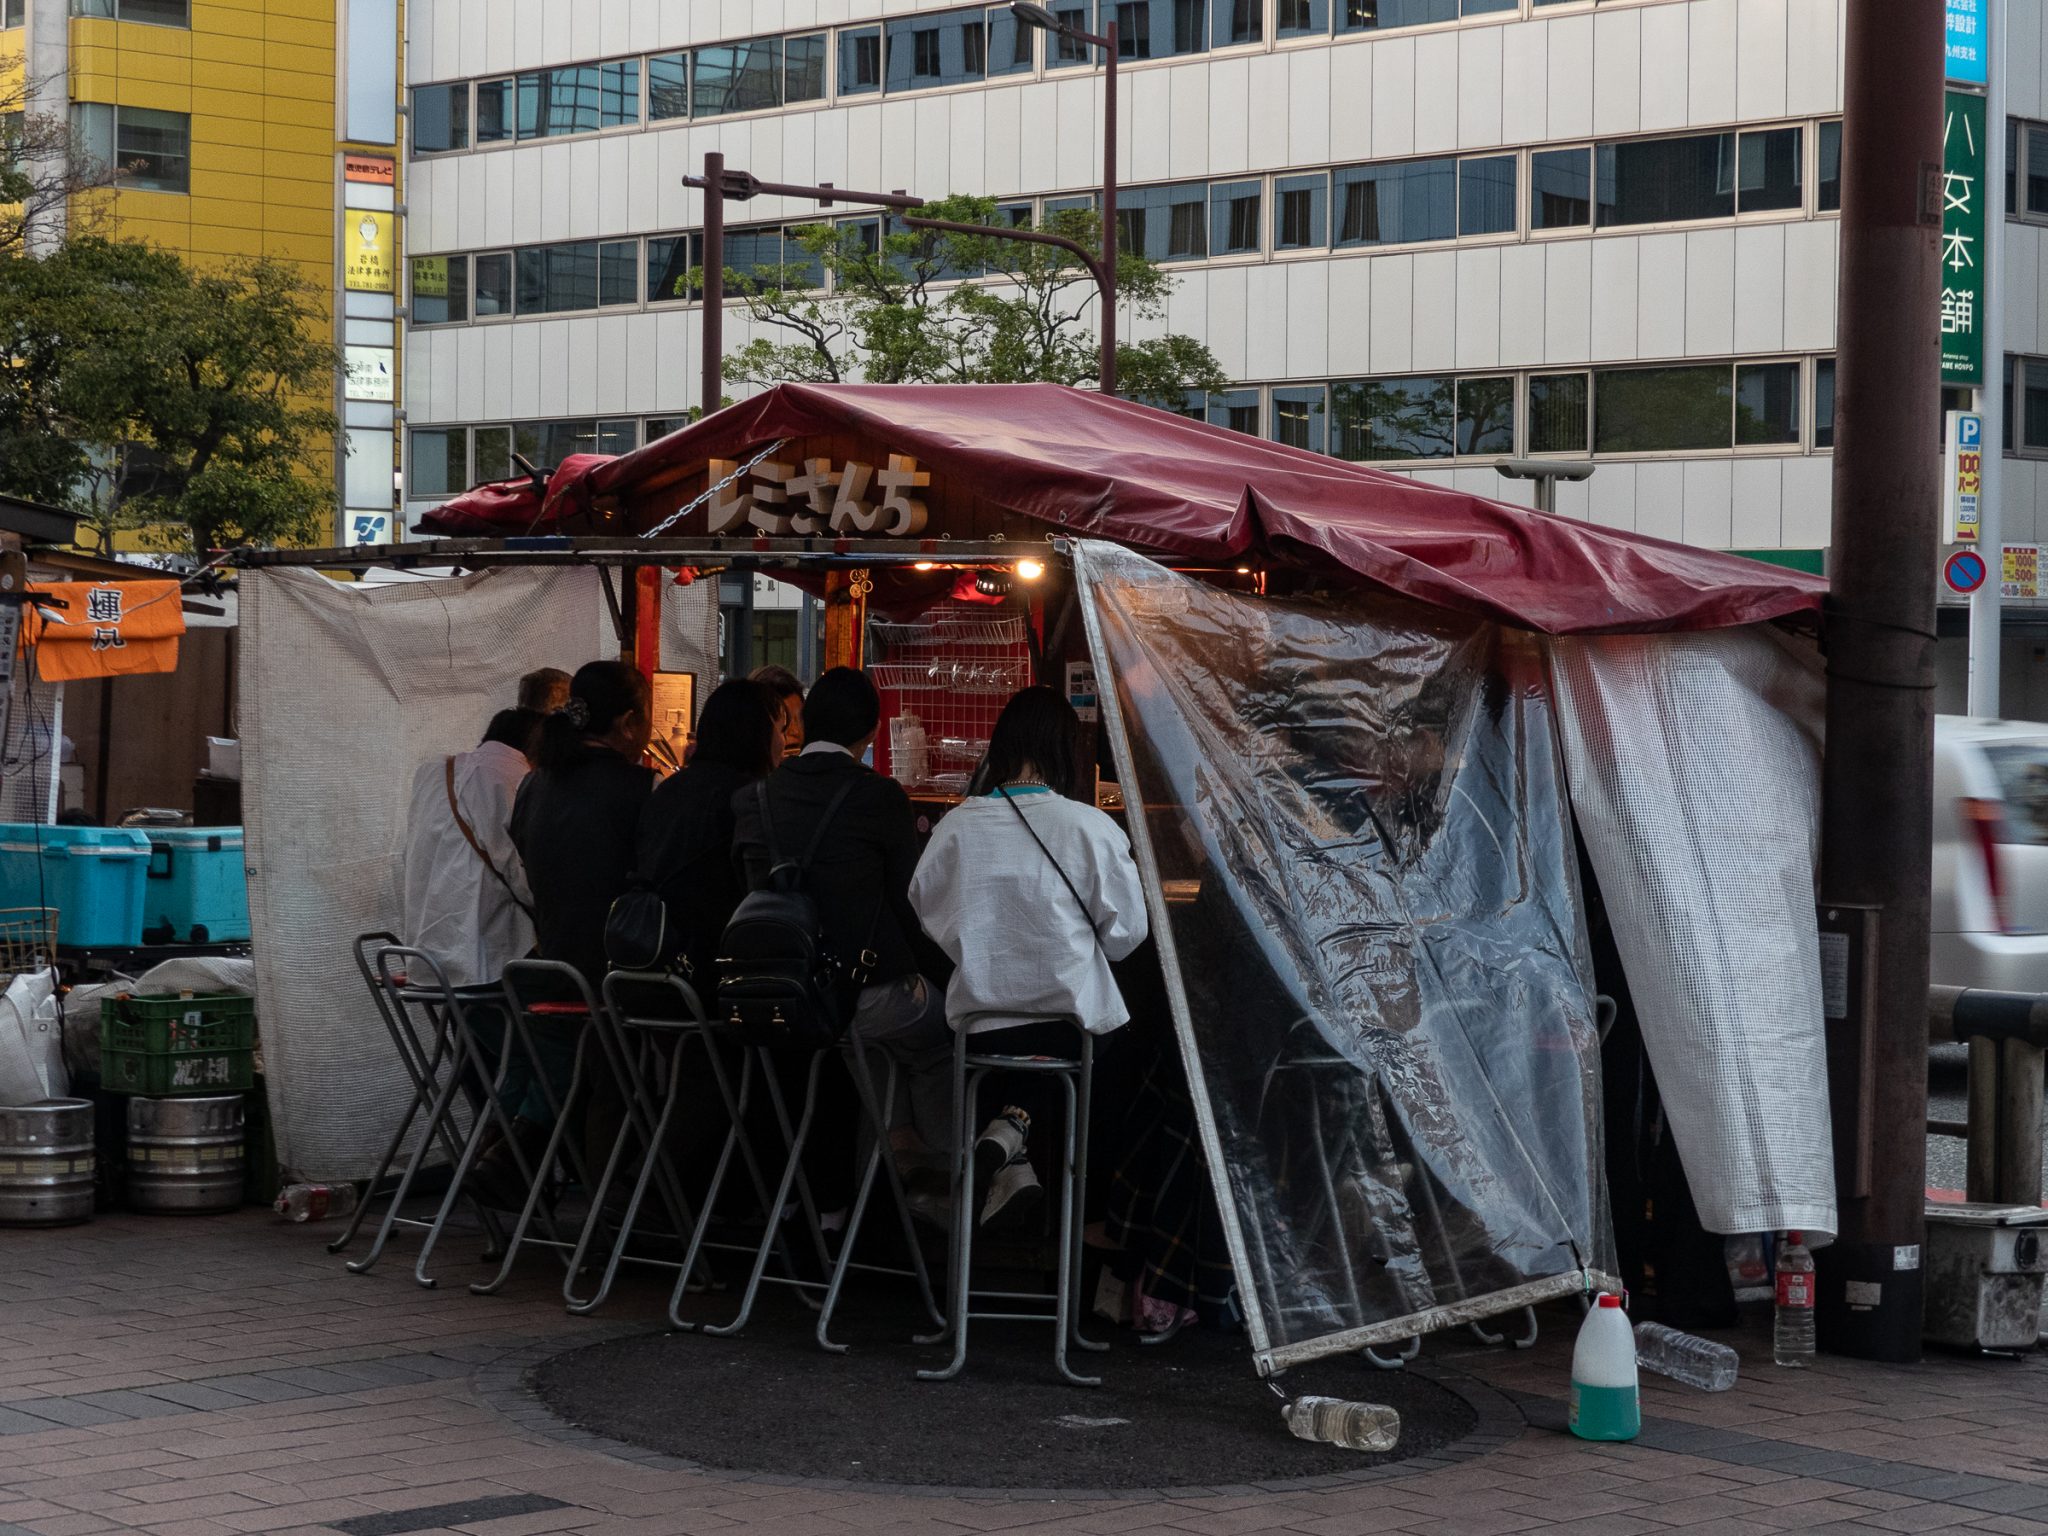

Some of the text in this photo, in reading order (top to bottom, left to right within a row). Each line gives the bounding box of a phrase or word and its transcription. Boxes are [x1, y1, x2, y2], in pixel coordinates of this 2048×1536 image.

[1941, 361, 1974, 372] AME HONPO
[708, 453, 931, 536] レミさんち
